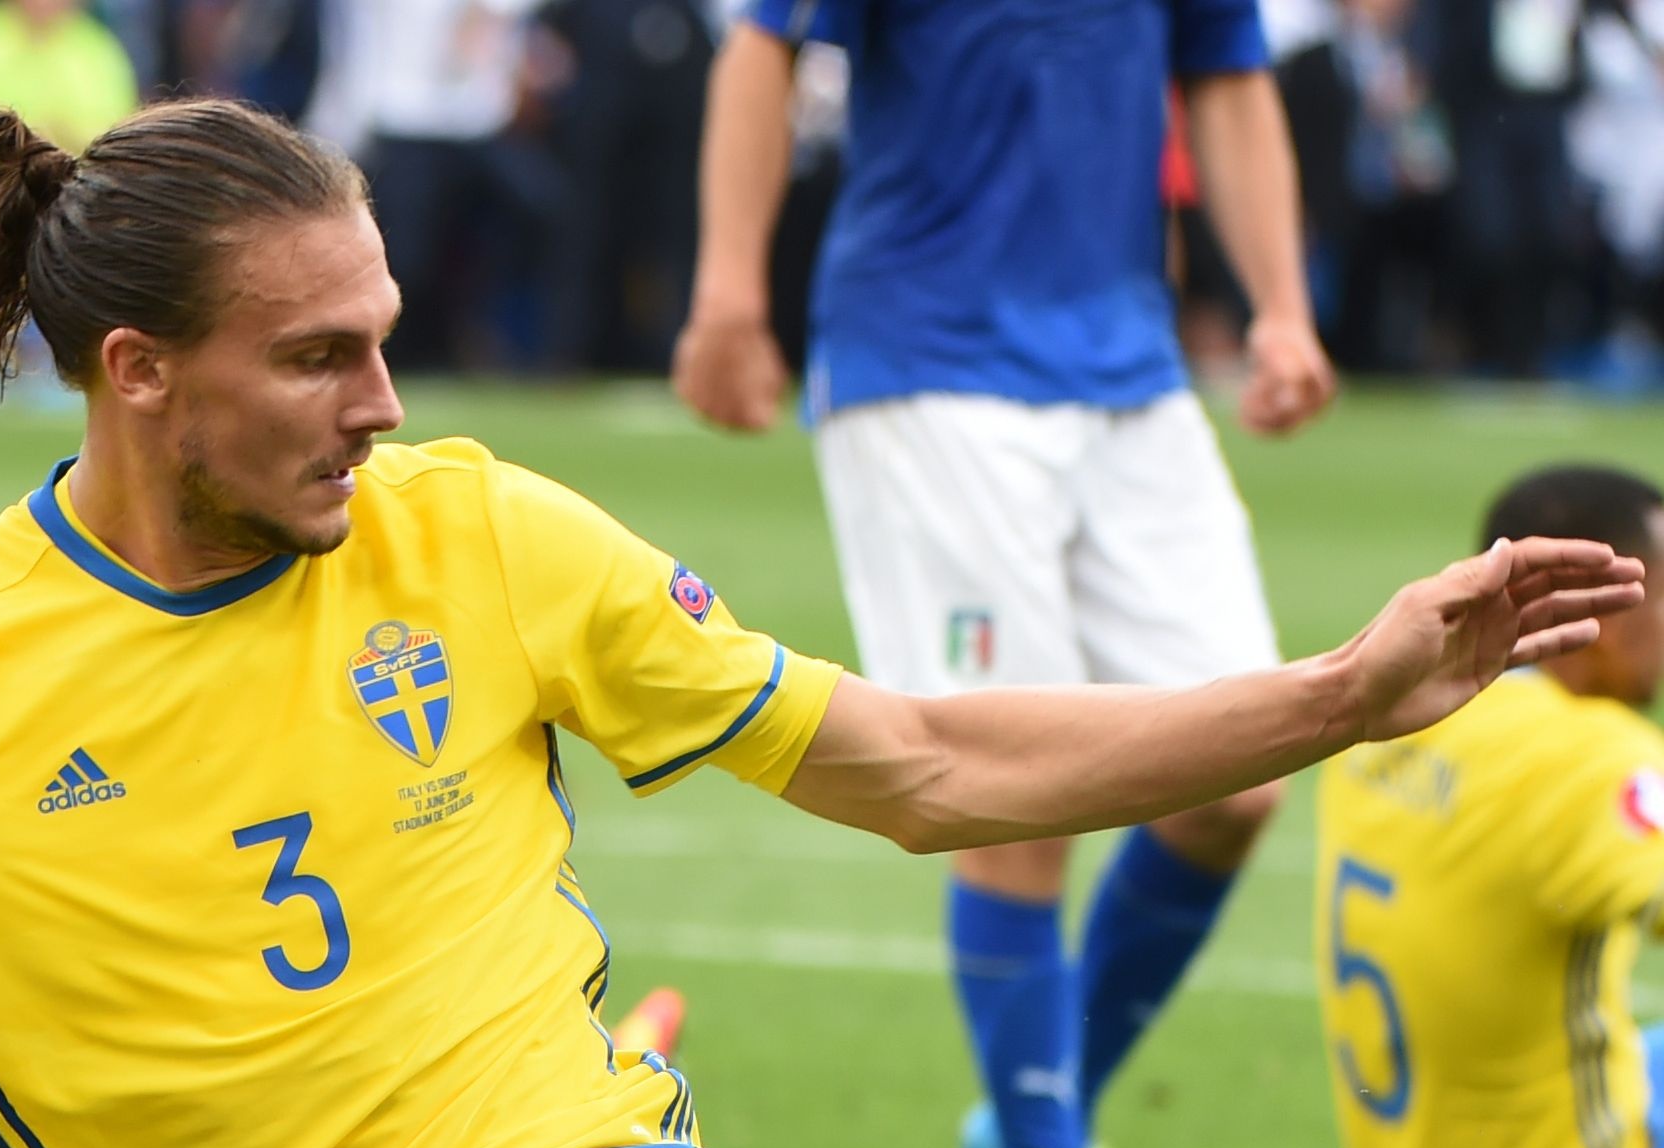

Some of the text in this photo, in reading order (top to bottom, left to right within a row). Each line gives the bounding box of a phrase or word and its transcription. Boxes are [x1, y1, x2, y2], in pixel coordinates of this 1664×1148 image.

[373, 650, 422, 676] SvFF
[38, 782, 126, 814] adidas
[398, 784, 422, 800] ITALY
[424, 780, 437, 793] VS
[425, 793, 445, 809] JUNE
[393, 813, 433, 833] STADIUM
[434, 809, 443, 822] DE
[232, 811, 351, 991] 3
[1331, 856, 1412, 1126] 5
